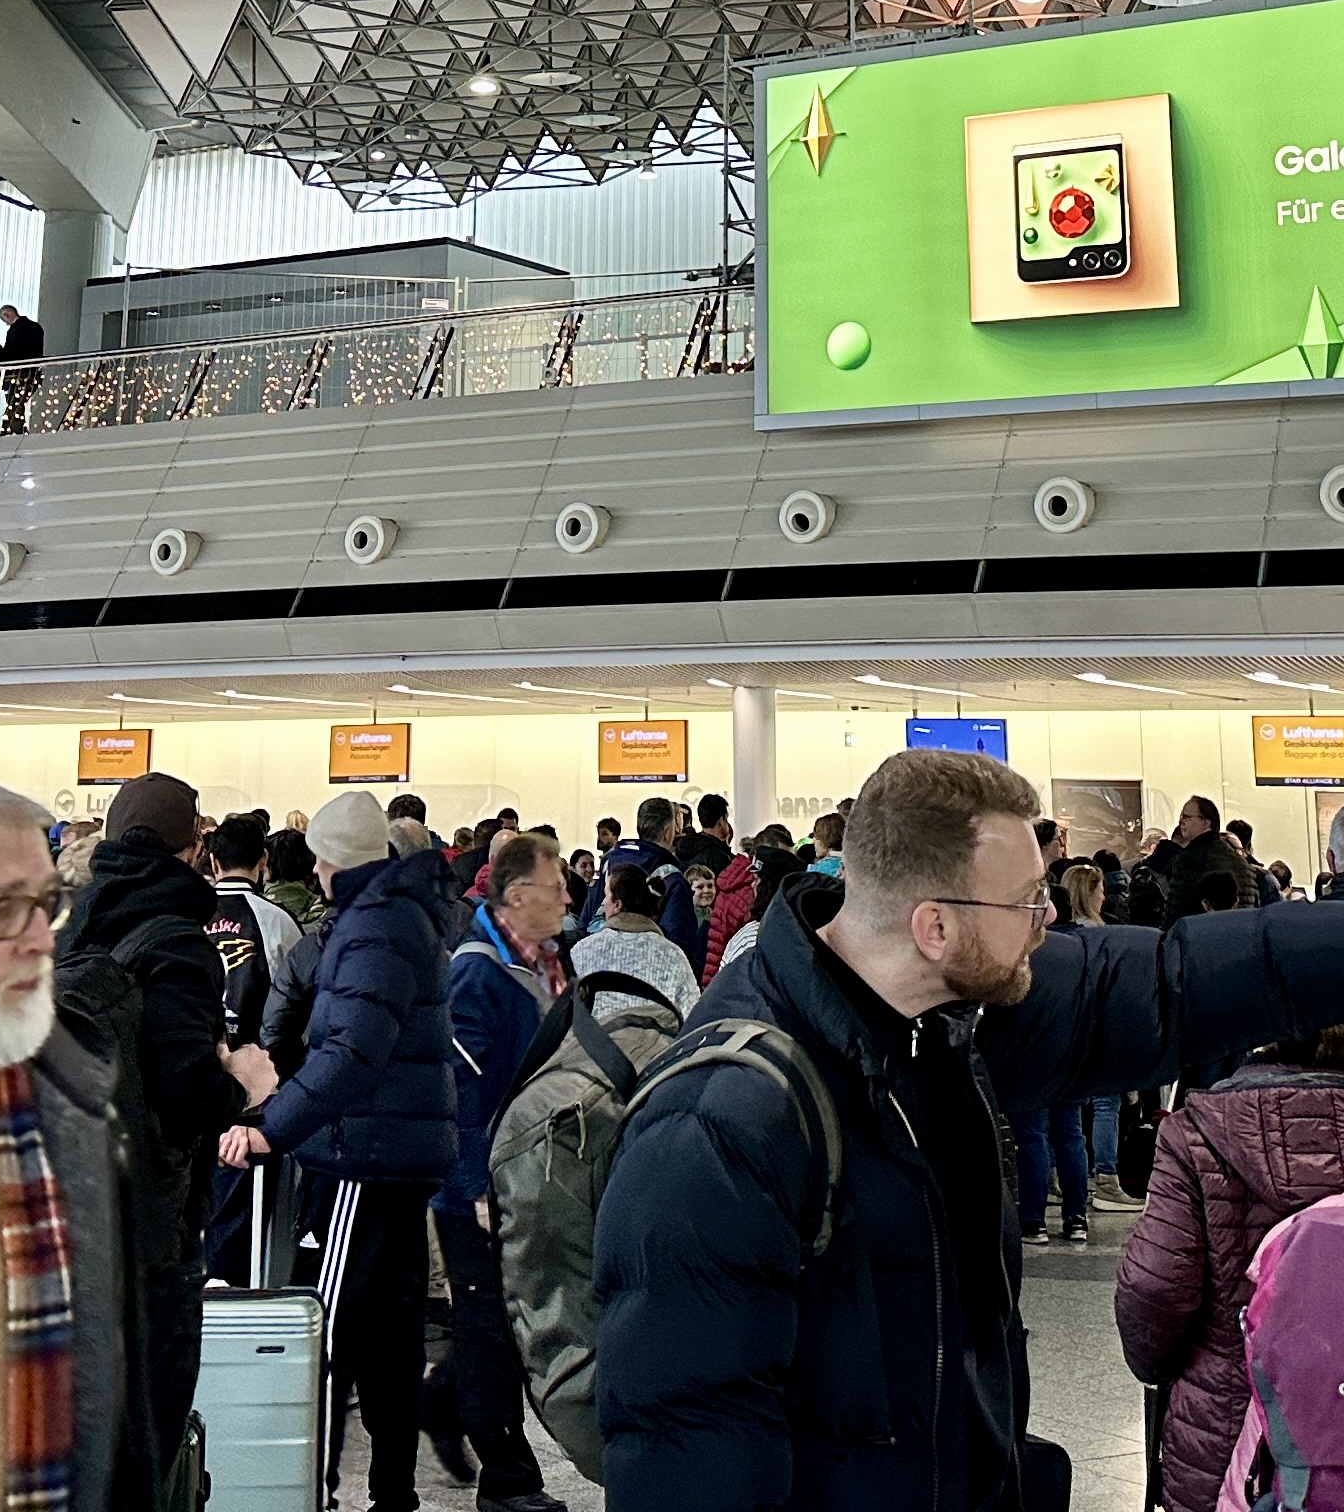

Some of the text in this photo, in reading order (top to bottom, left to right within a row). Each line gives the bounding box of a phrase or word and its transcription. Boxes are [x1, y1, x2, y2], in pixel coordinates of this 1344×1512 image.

[1276, 199, 1323, 226] Für
[350, 733, 392, 744] Lufthansa
[620, 730, 668, 741] Lufthansa
[1282, 726, 1344, 739] Lufthansa
